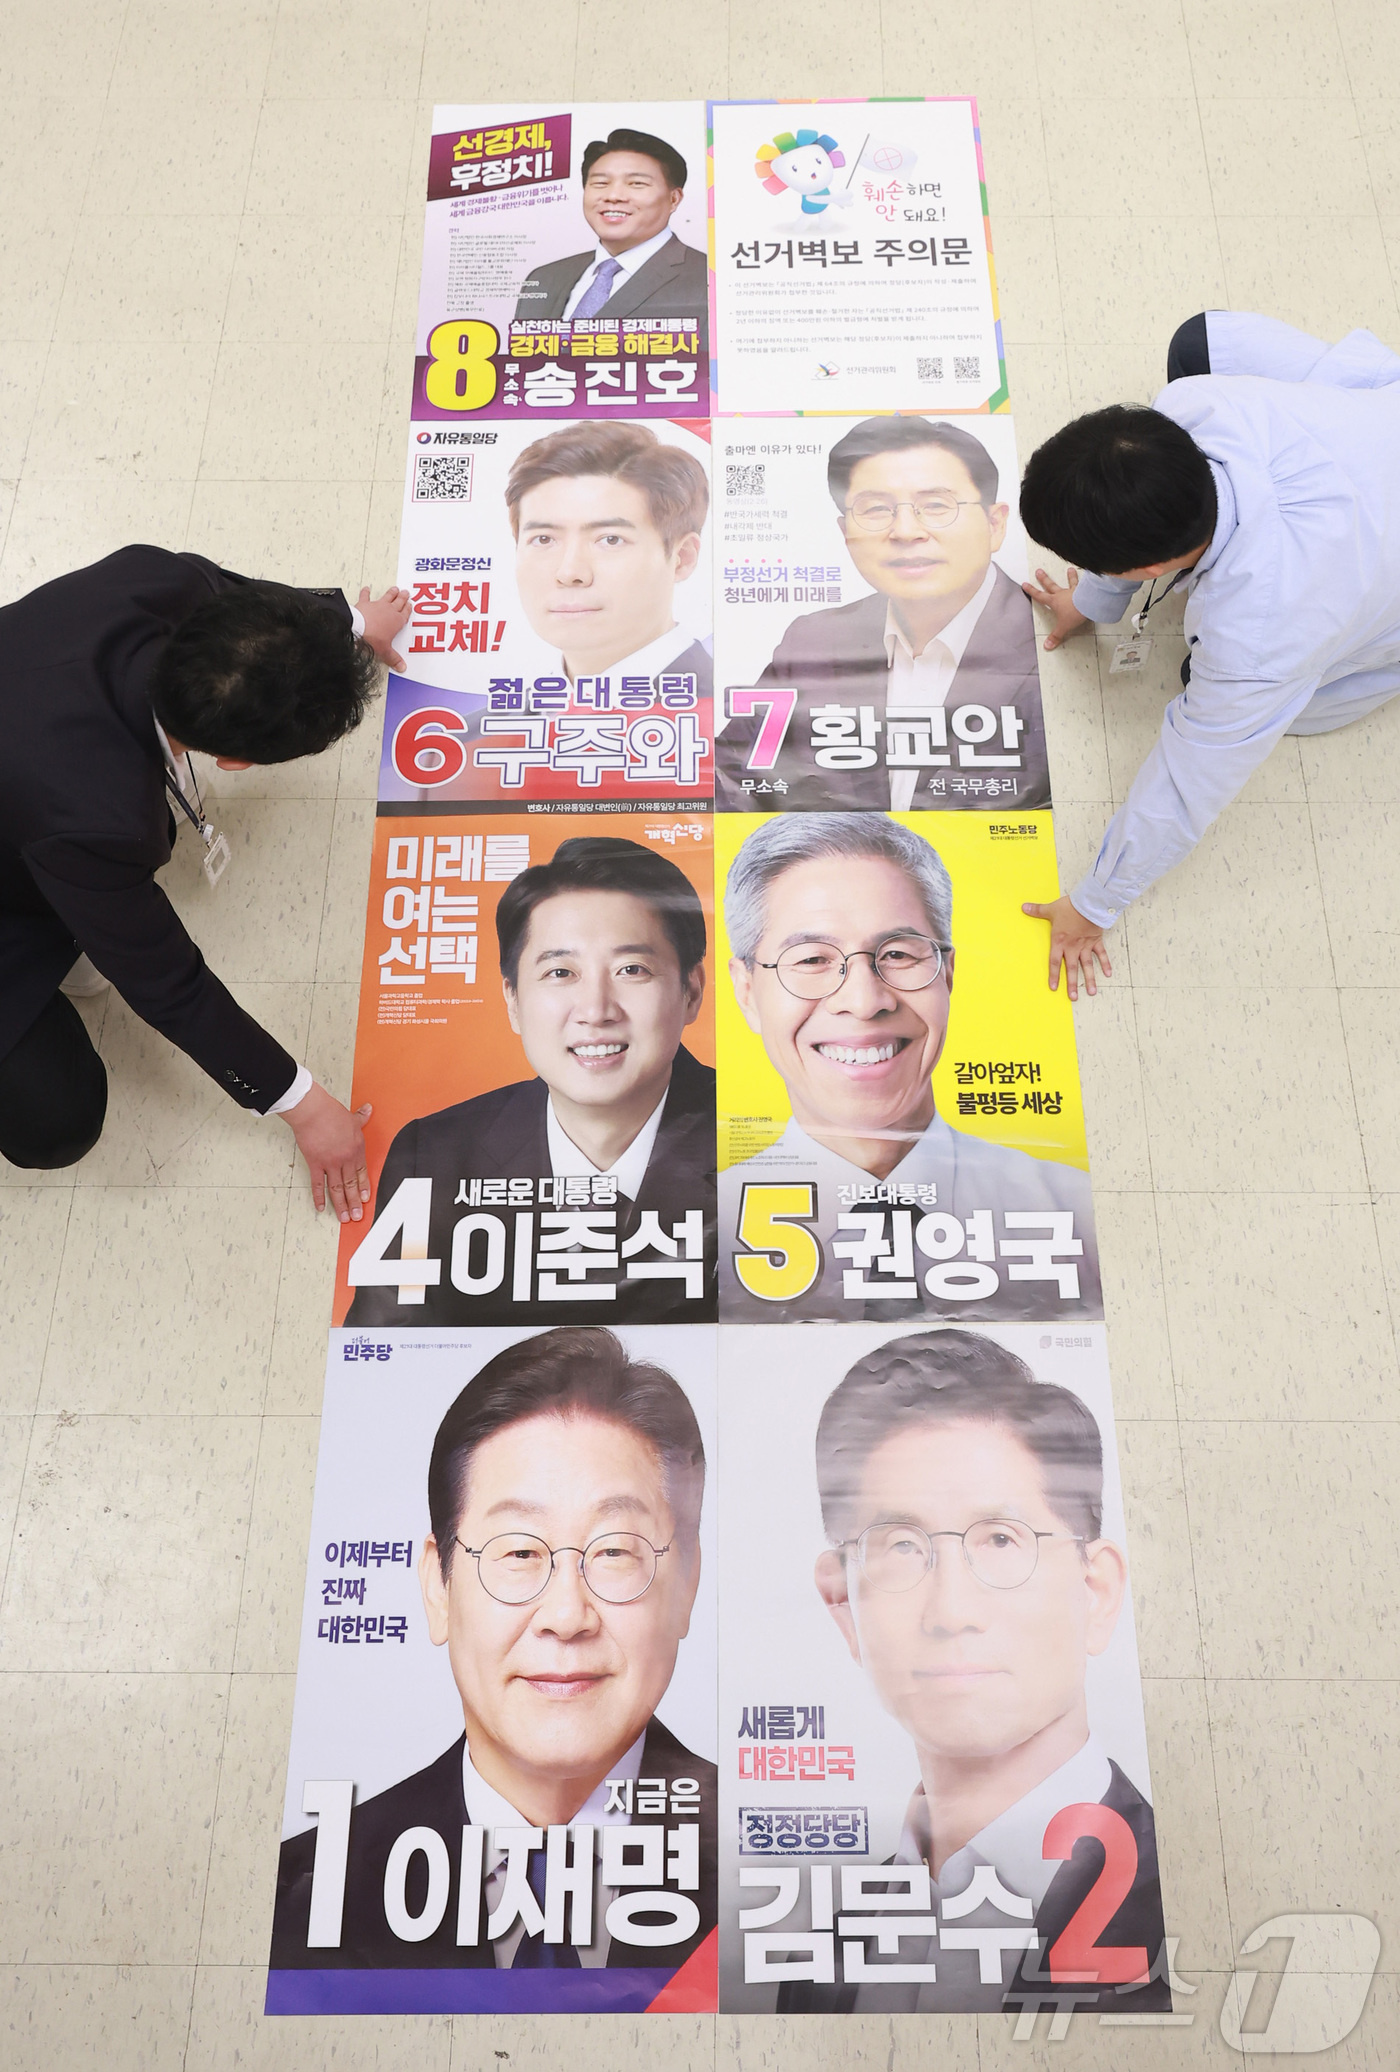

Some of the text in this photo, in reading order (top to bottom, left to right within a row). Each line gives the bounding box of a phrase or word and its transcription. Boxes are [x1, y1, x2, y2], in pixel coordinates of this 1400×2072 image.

[453, 123, 551, 161] 선경제,
[450, 151, 553, 191] 후정치!
[862, 180, 942, 202] 훼손하면
[876, 204, 946, 222] 안 돼요!
[730, 236, 973, 269] 선거벽보 주의문
[510, 318, 698, 334] 실천하는 준비된 경제대통령
[509, 333, 699, 357] 경제·금융 해결사
[426, 320, 497, 411] 8
[523, 359, 699, 408] 송진호
[433, 432, 498, 445] 자유통일당
[725, 444, 821, 456] 출마엔 이유가 있다!
[415, 557, 491, 572] 광화문정신
[724, 566, 842, 583] 부정선거 척결로
[411, 582, 490, 615] 정치
[724, 587, 842, 604] 청년에게 미래를
[409, 620, 506, 653] 교체!
[727, 688, 798, 769] 7
[809, 704, 1023, 769] 황교안
[393, 707, 468, 788] 6
[475, 714, 707, 786] 구주와
[740, 779, 789, 796] 무소속
[929, 778, 1018, 796] 전 국무총리
[527, 804, 550, 812] 변호사
[556, 804, 594, 812] 자유통일당
[638, 802, 676, 812] 자유통일당
[677, 802, 707, 811] 최고위원
[644, 823, 704, 845] 개혁신당
[989, 825, 1037, 835] 민주노동당
[386, 834, 531, 882] 미래를
[382, 885, 478, 933] 여는
[378, 936, 478, 985] 선택
[954, 1061, 1042, 1085] 갈아엎자!
[956, 1091, 1063, 1115] 불평등 세상
[454, 1176, 618, 1207] 새로운 대통령
[837, 1183, 937, 1205] 진보대통령
[347, 1177, 441, 1305] 4
[450, 1209, 704, 1302] 이준석
[734, 1182, 822, 1301] 5
[832, 1209, 1084, 1301] 권영국
[343, 1344, 393, 1361] 민주당
[1055, 1337, 1092, 1348] 국민의힘
[324, 1540, 413, 1568] 이제부터
[320, 1577, 367, 1605] 진짜
[317, 1615, 408, 1644] 대한민국
[738, 1705, 825, 1740] 새롭게
[738, 1745, 855, 1781] 대한민국
[604, 1777, 700, 1814] 지금은
[746, 1813, 861, 1849] 정정당당
[302, 1780, 354, 1947] 1
[383, 1823, 700, 1947] 이재명
[1042, 1802, 1150, 1984] 2
[738, 1864, 1040, 1984] 김문수
